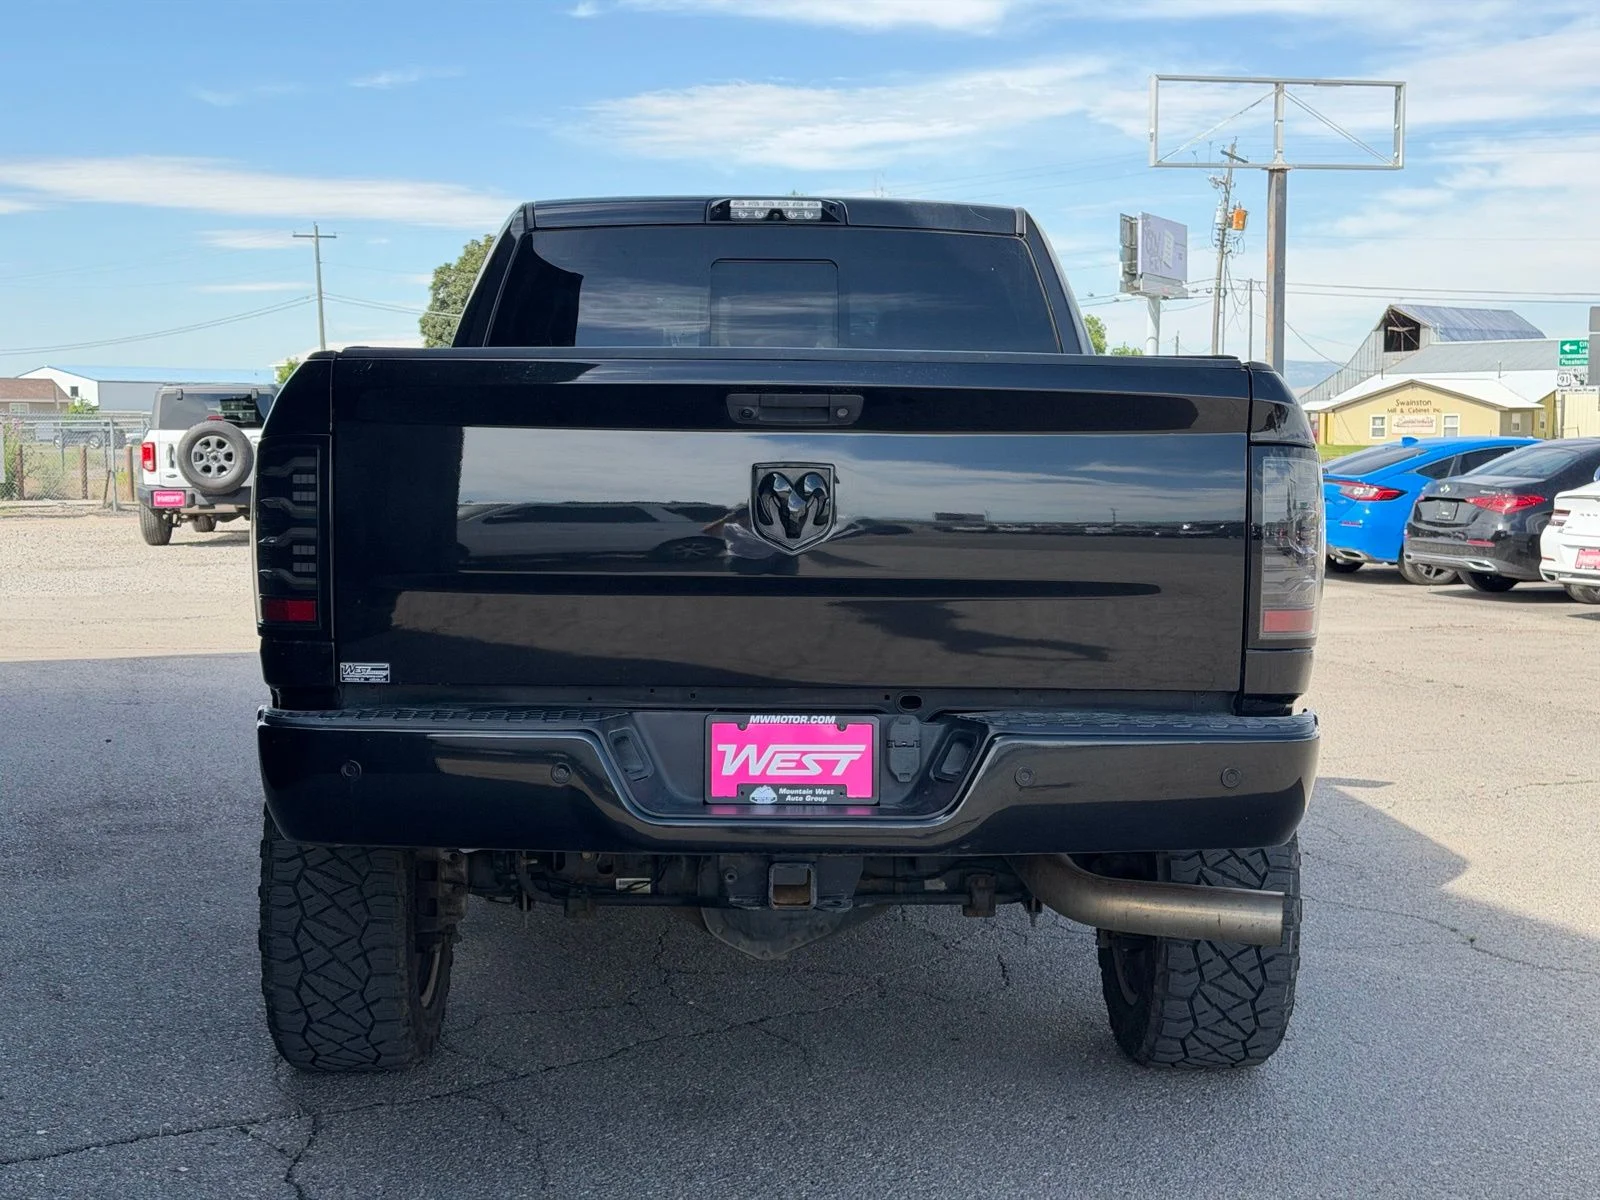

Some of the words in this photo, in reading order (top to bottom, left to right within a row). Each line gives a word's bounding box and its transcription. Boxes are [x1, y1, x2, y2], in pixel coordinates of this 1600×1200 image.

[1395, 399, 1432, 407] Swainston
[749, 715, 836, 724] MWMOTOR.COM
[717, 744, 866, 776] WEST
[805, 795, 828, 803] Group
